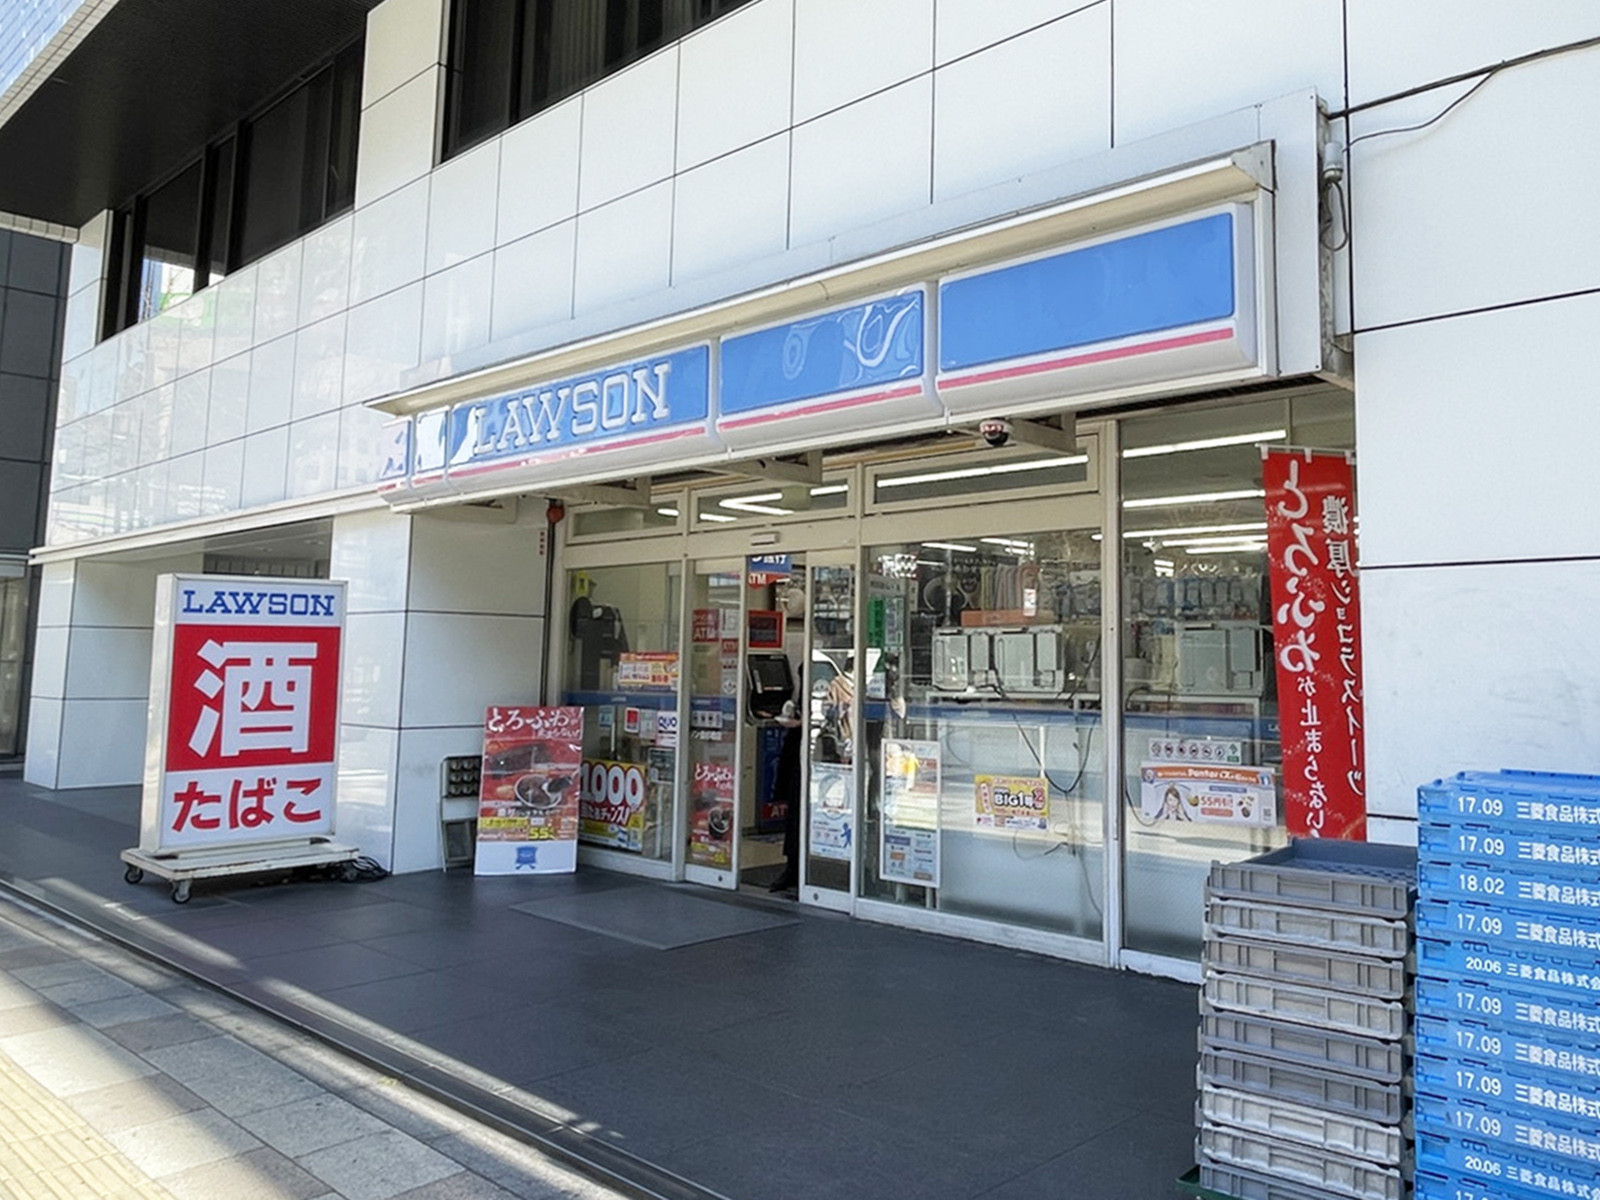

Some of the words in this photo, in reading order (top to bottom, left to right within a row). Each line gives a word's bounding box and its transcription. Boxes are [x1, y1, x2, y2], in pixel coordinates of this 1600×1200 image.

[473, 361, 670, 456] LAWSON
[182, 589, 335, 616] LAWSON
[187, 639, 318, 758] 酒
[658, 715, 678, 729] QUO
[172, 777, 322, 832] たばこ
[1458, 797, 1503, 816] 17.09
[1459, 836, 1505, 855] 17.09
[1459, 874, 1505, 895] 18.02
[1457, 914, 1503, 934] 17.09
[1466, 957, 1502, 974] 20.06
[1456, 992, 1502, 1015] 17.09
[1456, 1031, 1501, 1055] 17.09
[1456, 1071, 1502, 1095] 17.09
[1456, 1111, 1501, 1136] 17.09
[1465, 1155, 1502, 1176] 20.06
